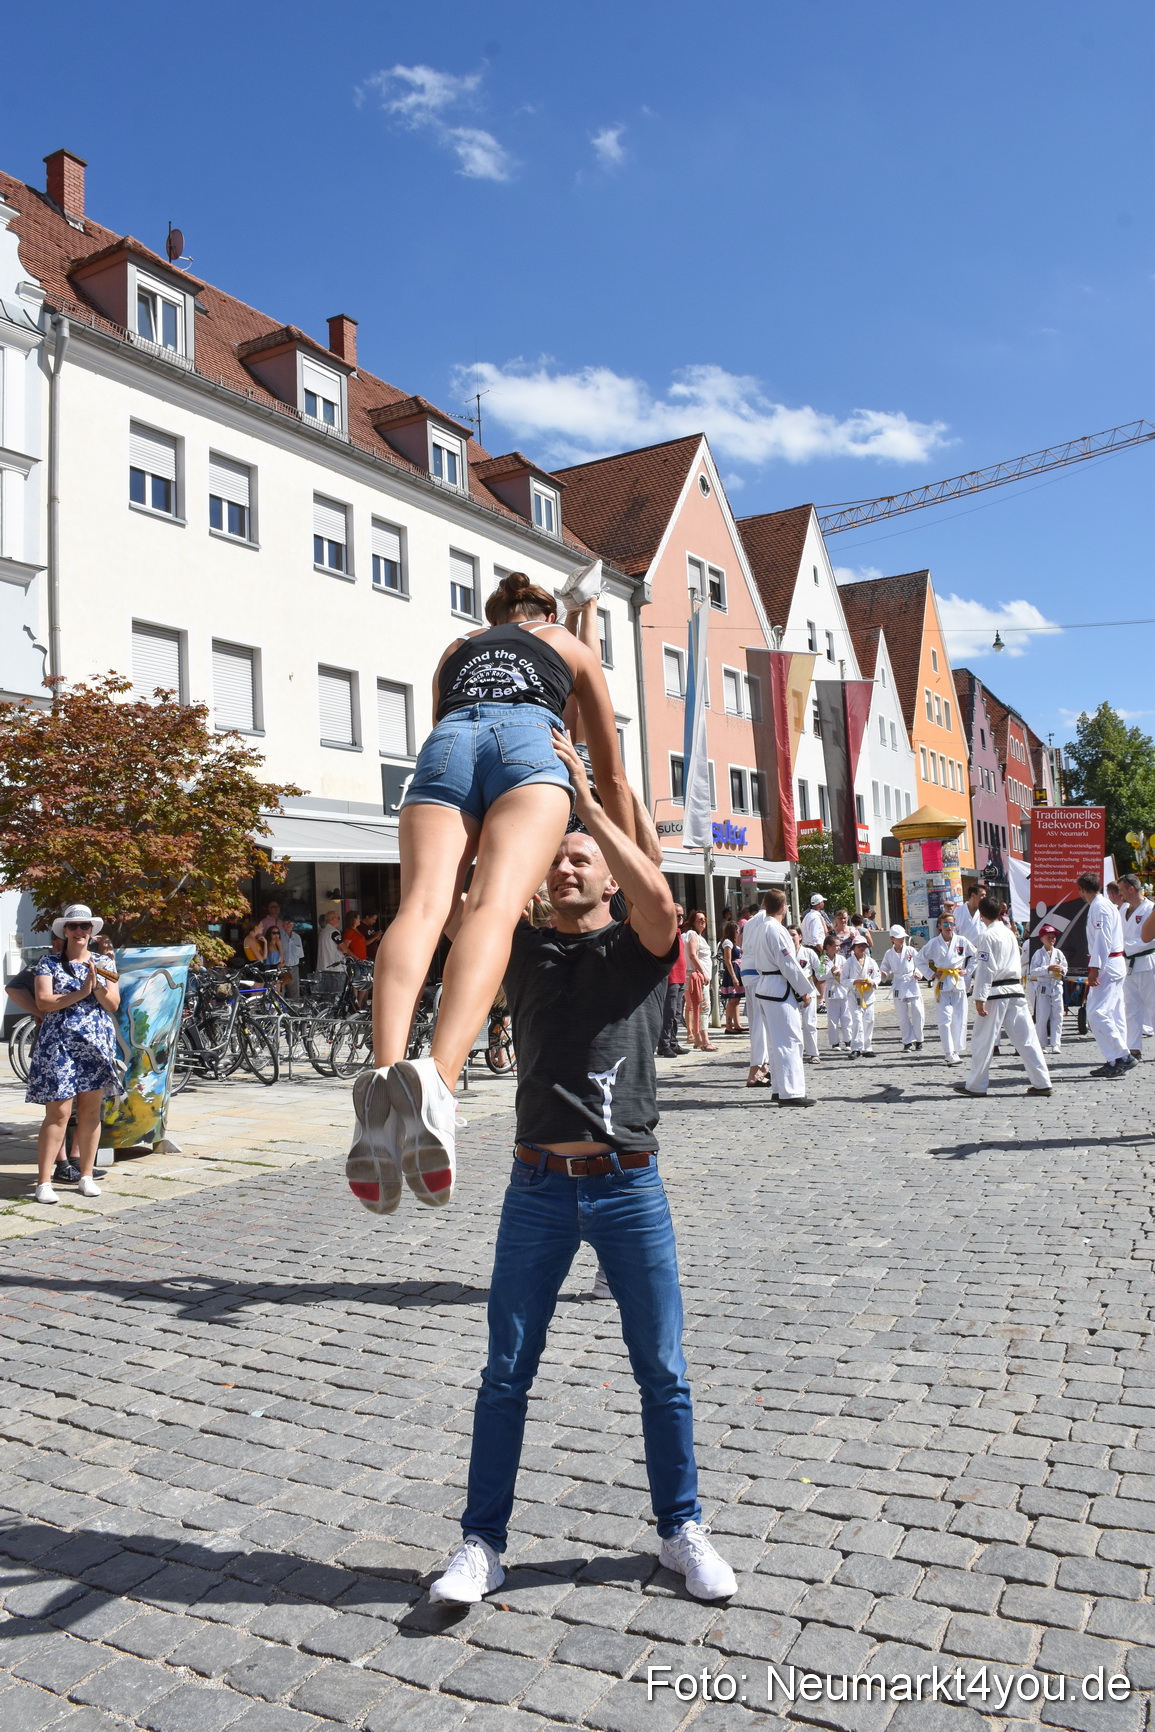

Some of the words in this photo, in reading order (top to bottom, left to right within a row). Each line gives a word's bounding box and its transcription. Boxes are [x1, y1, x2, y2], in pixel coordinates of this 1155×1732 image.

[494, 649, 517, 660] the
[467, 686, 488, 698] SV
[1035, 810, 1102, 819] Traditionelles
[657, 822, 683, 833] suto
[1036, 820, 1101, 829] Taekwon-Do
